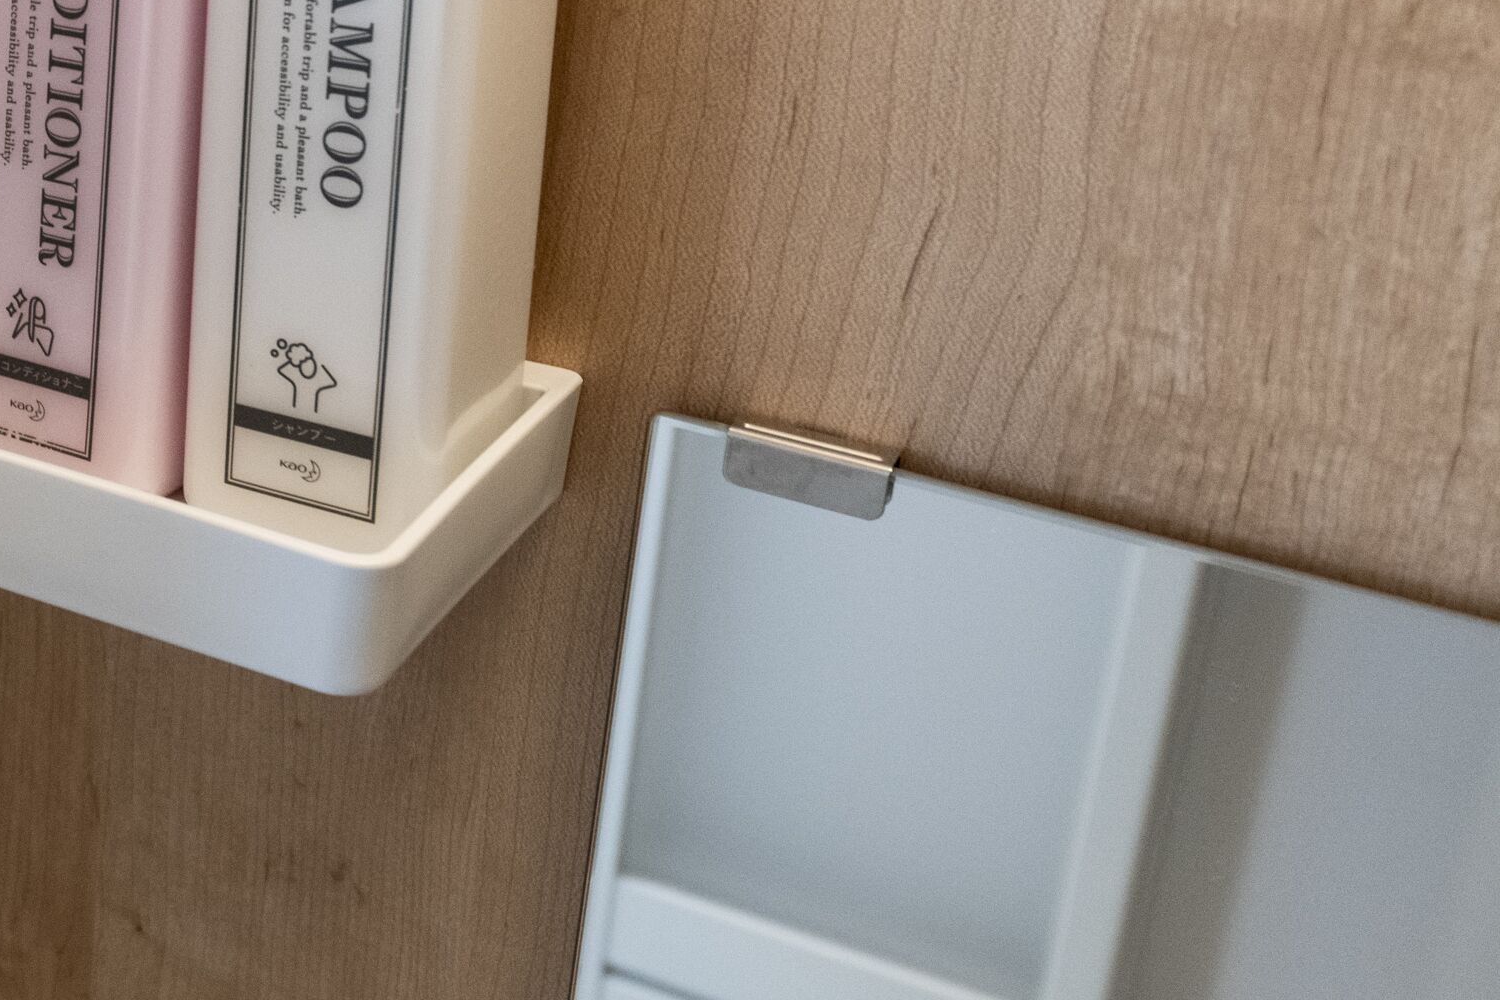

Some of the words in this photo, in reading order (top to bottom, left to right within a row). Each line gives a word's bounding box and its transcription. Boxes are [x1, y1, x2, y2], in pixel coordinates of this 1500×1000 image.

[24, 14, 39, 40] trip
[281, 10, 296, 33] for
[25, 41, 38, 68] and
[296, 54, 314, 82] trip
[5, 78, 17, 105] and
[272, 34, 292, 121] accessibility
[21, 80, 37, 136] pleasant
[298, 83, 313, 111] and
[274, 122, 289, 150] and
[20, 137, 34, 170] bath.
[293, 124, 311, 182] pleasant
[268, 152, 287, 214] usability.
[292, 184, 308, 219] bath.
